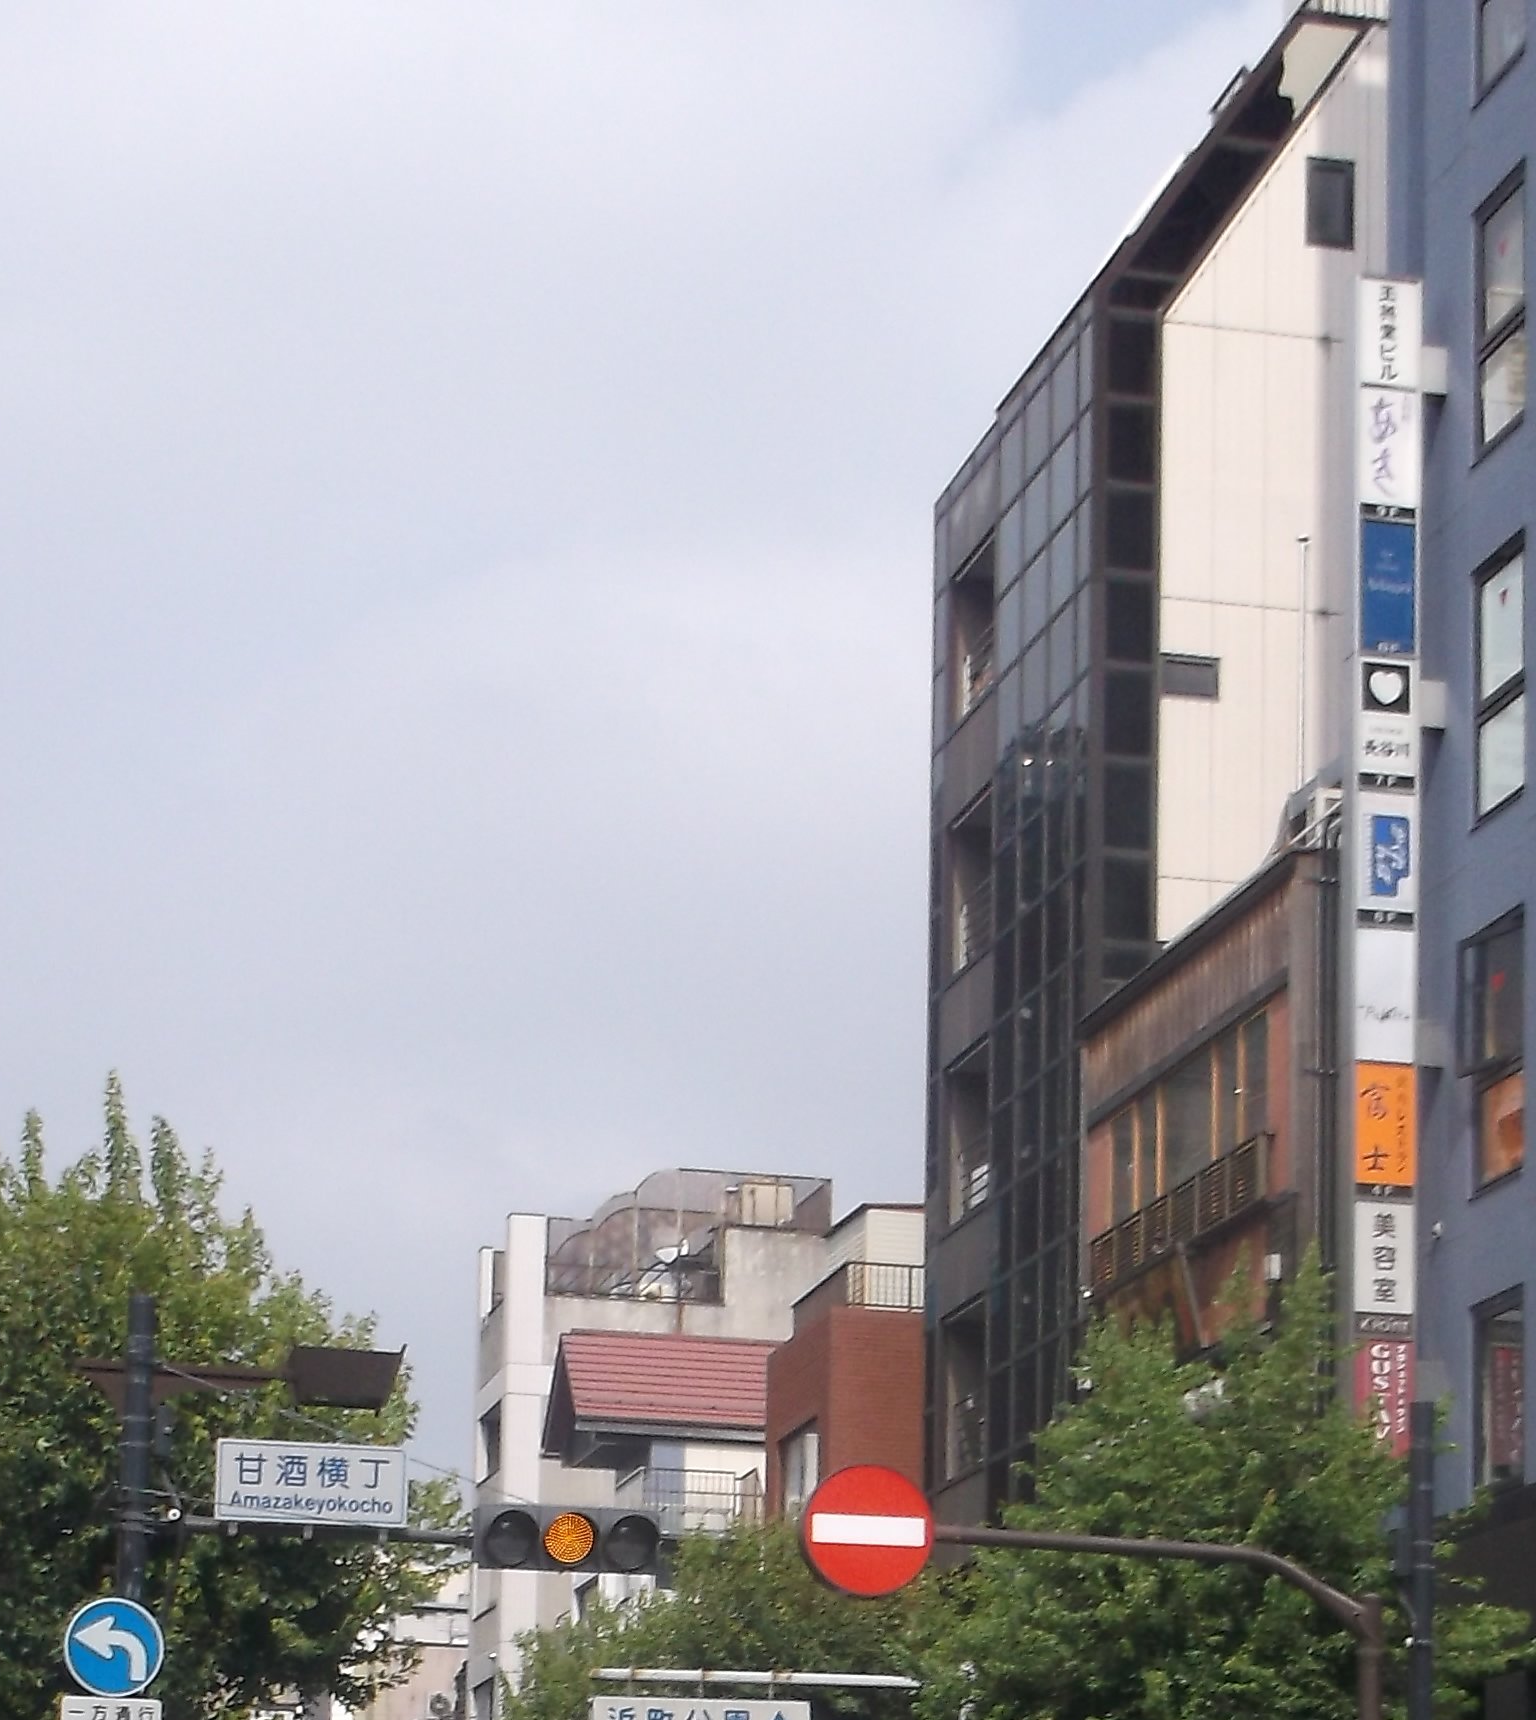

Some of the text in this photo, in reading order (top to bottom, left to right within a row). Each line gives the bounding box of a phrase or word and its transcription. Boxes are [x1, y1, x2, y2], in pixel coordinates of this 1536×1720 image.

[234, 1453, 392, 1489] 甘酒横丁
[229, 1489, 395, 1516] Amazakeyokocho
